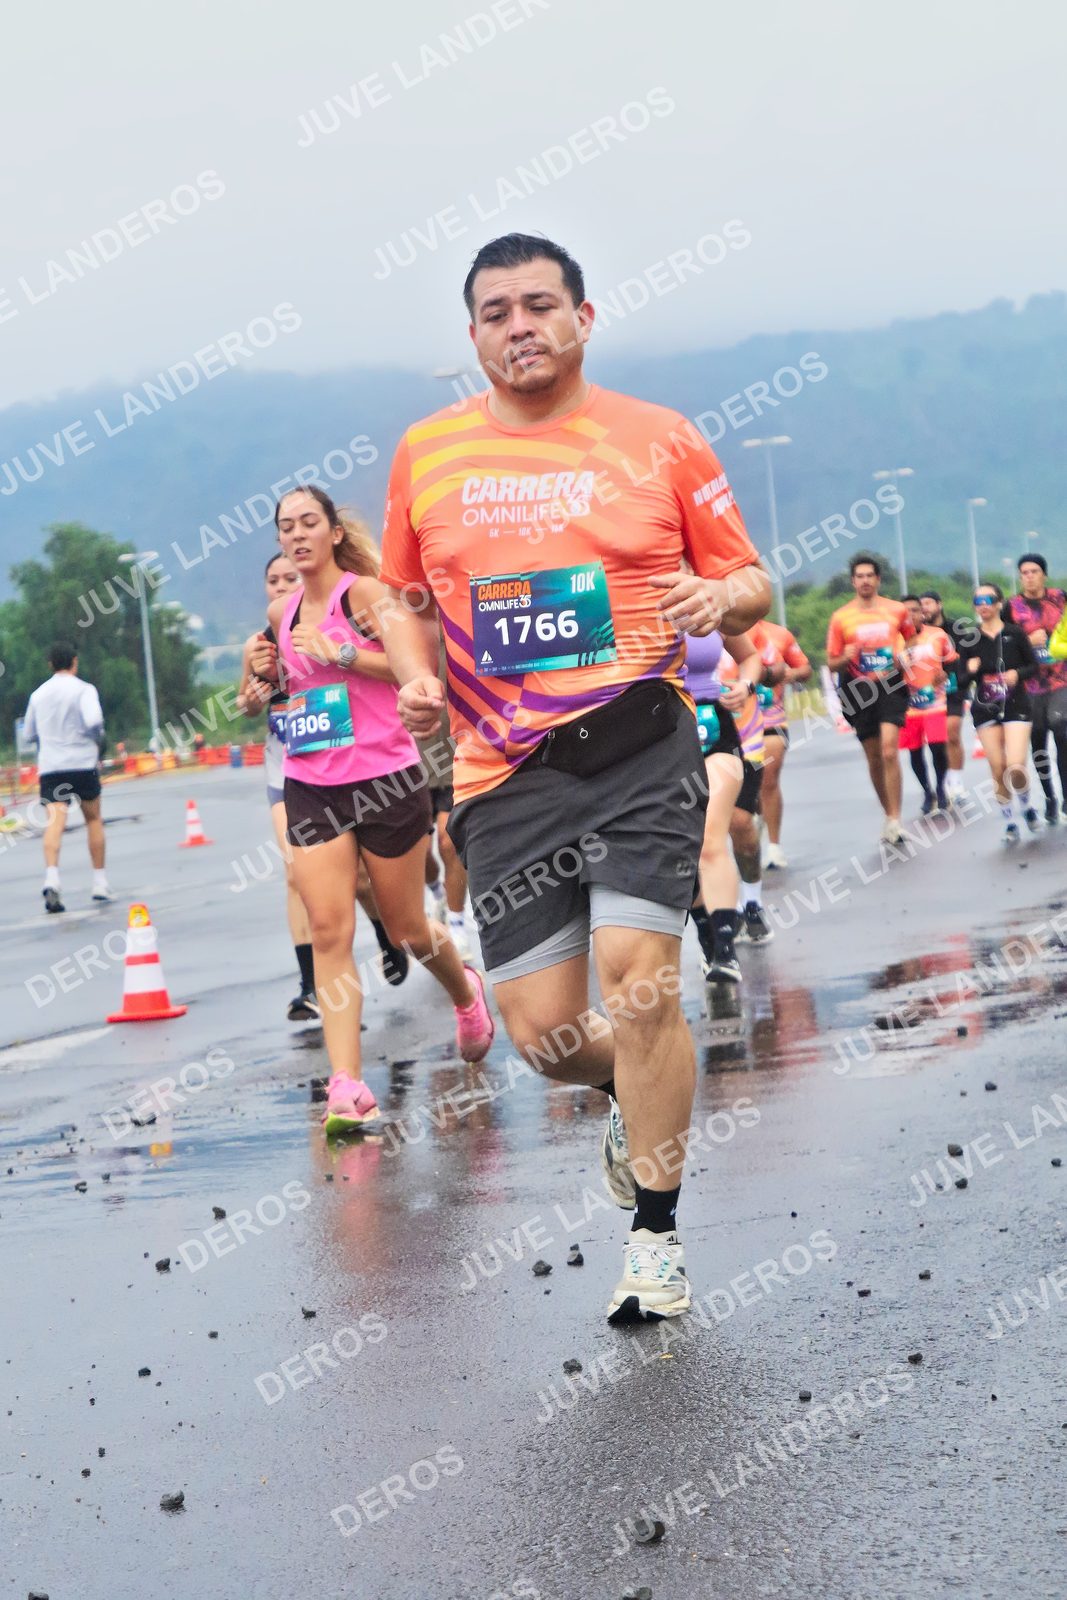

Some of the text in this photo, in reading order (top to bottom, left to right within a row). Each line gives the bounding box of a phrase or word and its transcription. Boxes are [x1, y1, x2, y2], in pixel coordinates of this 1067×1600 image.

[462, 470, 594, 505] CARRERA
[462, 502, 563, 527] OMNILIFE
[478, 580, 532, 600] CARRERA
[570, 571, 596, 594] 10K
[478, 598, 519, 612] OMNILIFE
[494, 610, 579, 646] 1766
[290, 712, 331, 738] 1306
